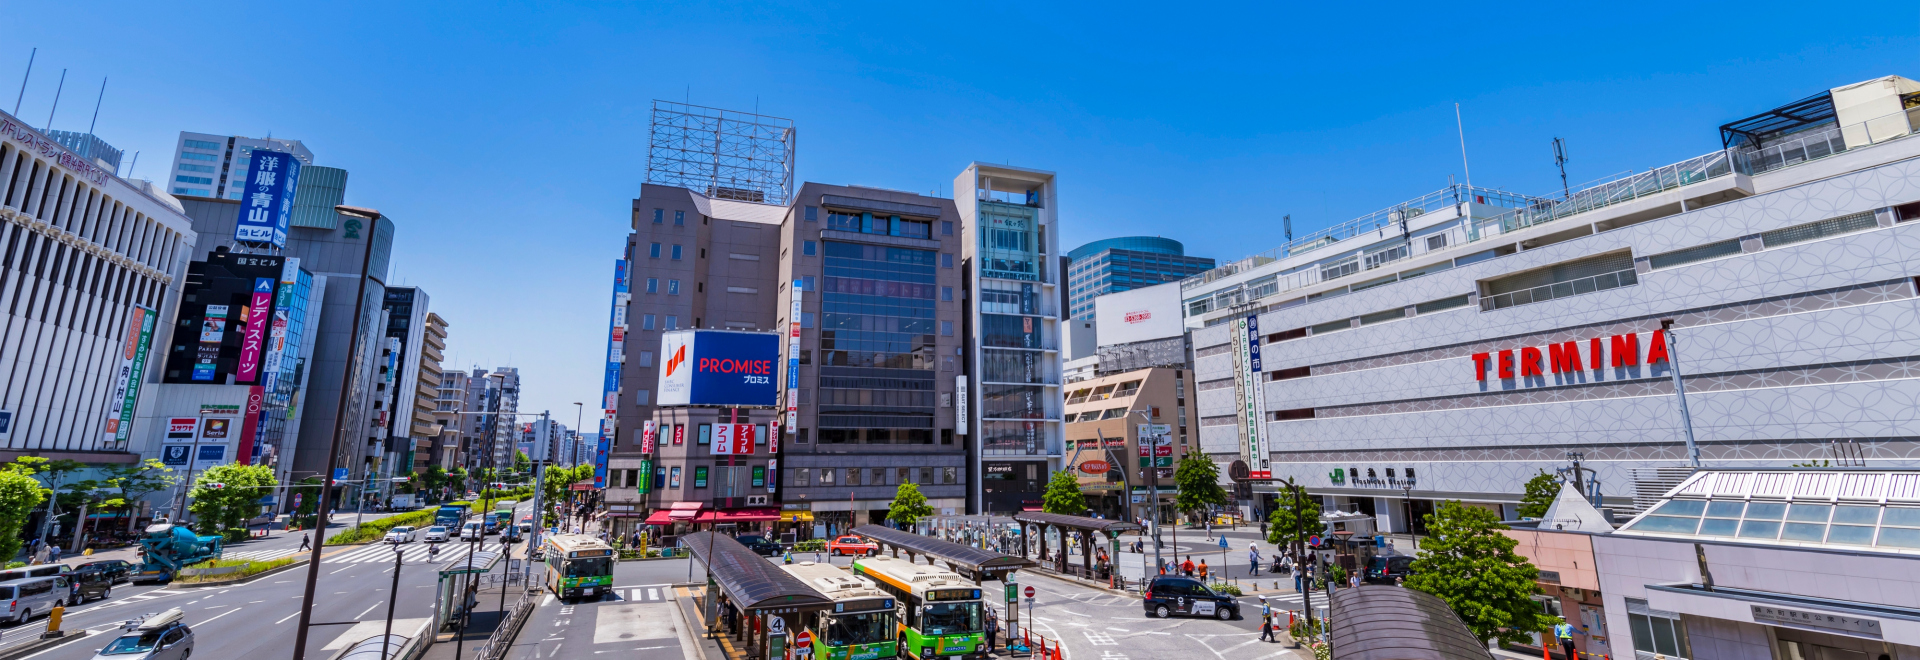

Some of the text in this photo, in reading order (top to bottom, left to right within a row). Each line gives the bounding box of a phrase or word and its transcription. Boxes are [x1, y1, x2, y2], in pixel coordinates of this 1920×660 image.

[248, 156, 279, 222] 洋服の青山
[279, 162, 297, 229] 洋服の青山
[239, 228, 271, 238] 当ビル
[237, 257, 278, 267] 国宝ビル
[243, 295, 269, 374] レディススーツ
[1471, 329, 1670, 381] TERMINA
[700, 358, 771, 375] PROMISE
[744, 375, 769, 384] プロミス
[717, 425, 728, 453] アコム
[740, 425, 748, 453] アイフル
[1329, 468, 1344, 480] JR
[1350, 467, 1415, 478] 錦糸町駅
[1389, 478, 1416, 486] Station
[773, 619, 782, 630] 4
[1754, 606, 1875, 628] 錦糸町駅前公衆トイレ
